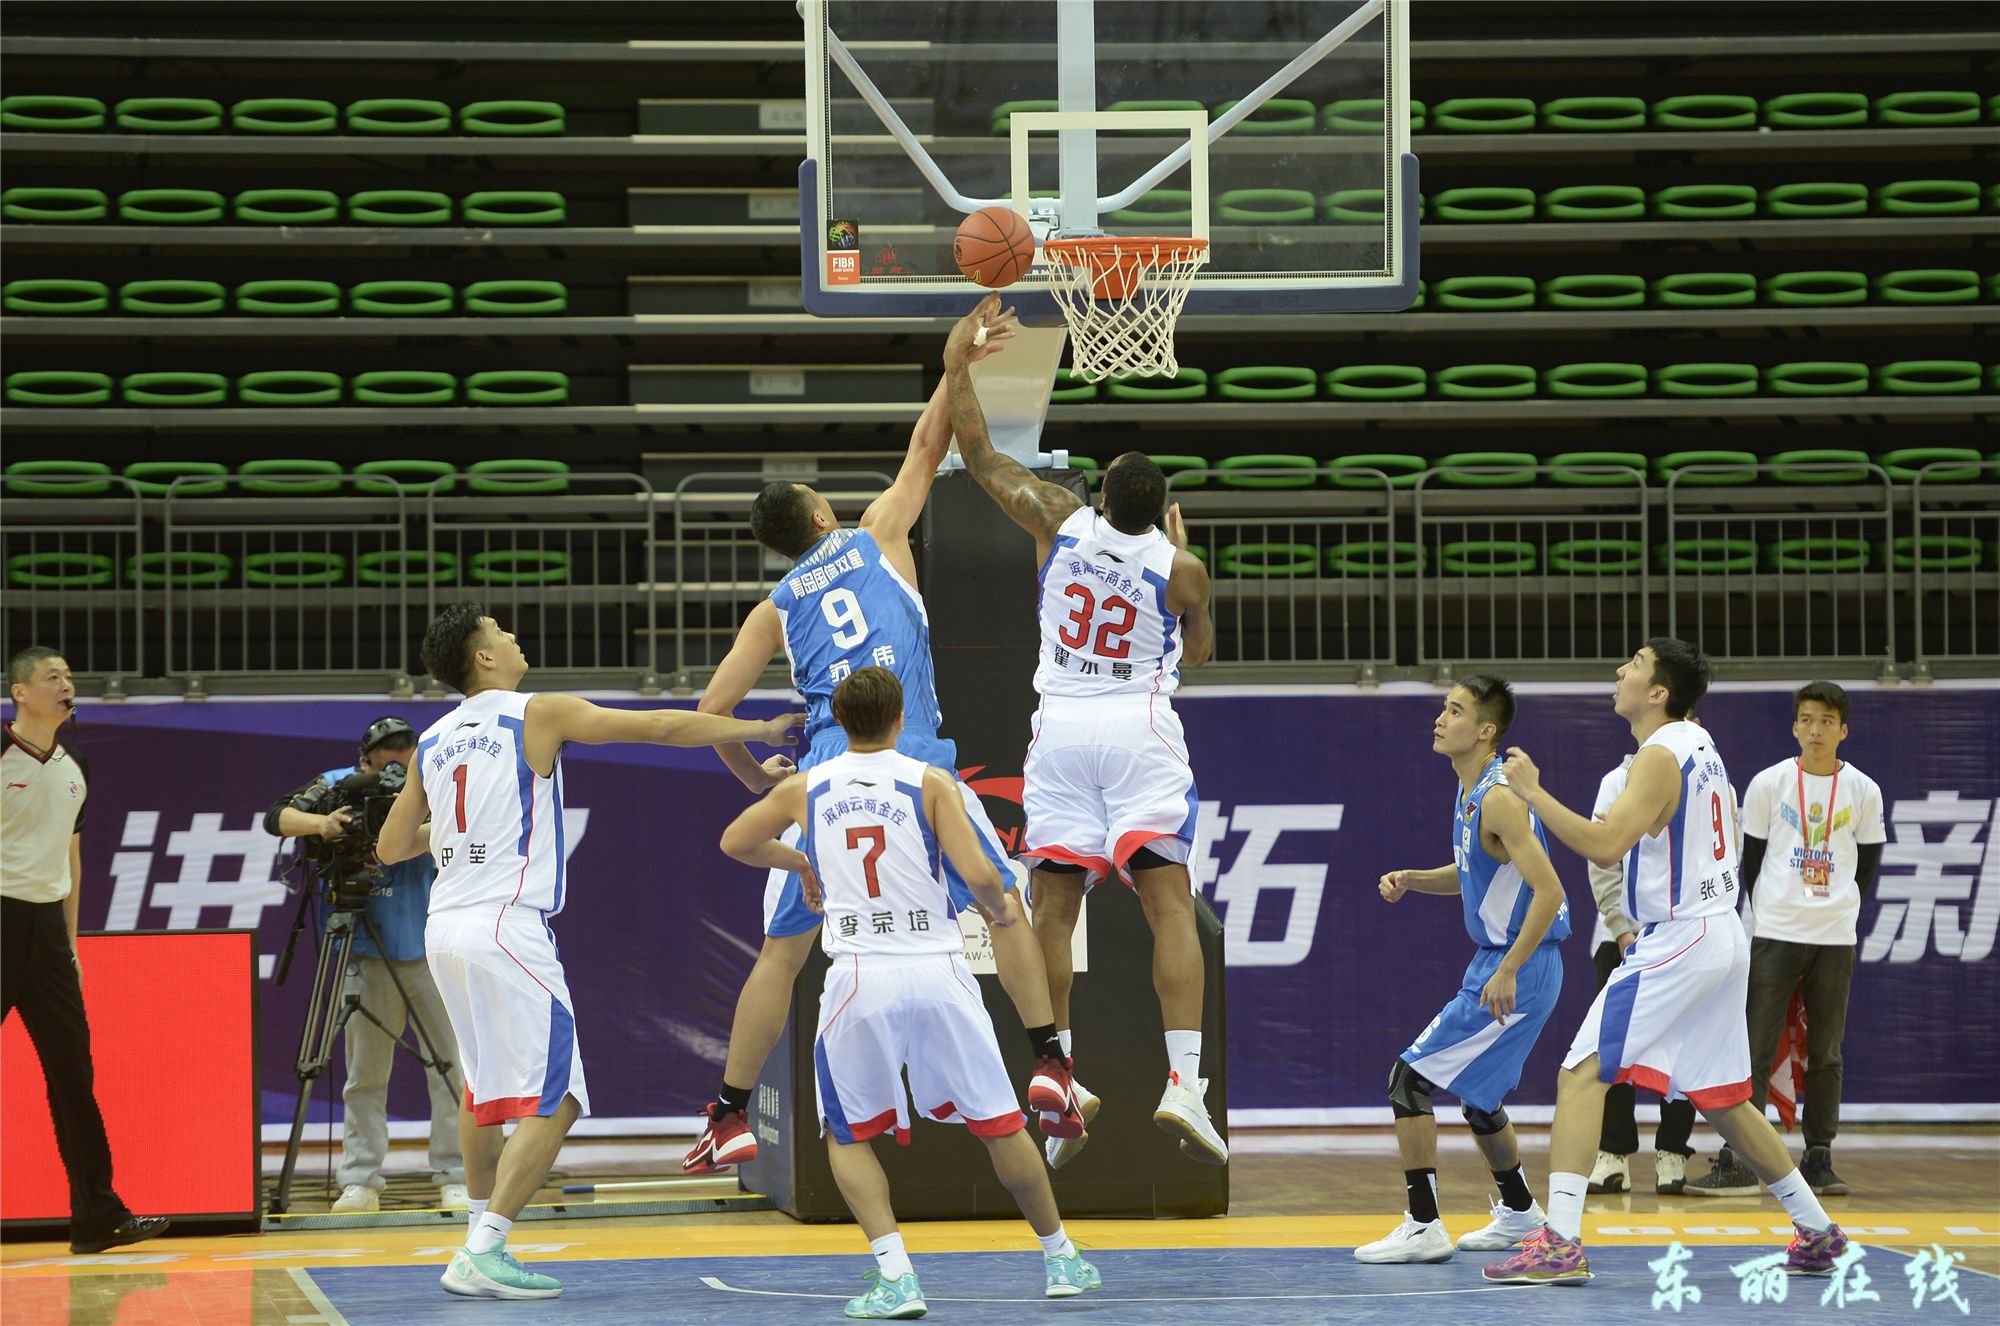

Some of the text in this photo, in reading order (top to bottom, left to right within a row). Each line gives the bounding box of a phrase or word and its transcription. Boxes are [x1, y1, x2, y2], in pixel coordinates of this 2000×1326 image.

[833, 257, 854, 268] FIBA
[788, 548, 865, 599] 青岛国信双星
[1069, 560, 1143, 604] 滨海云商金控
[820, 587, 869, 649] 9
[1059, 582, 1137, 659] 32
[453, 764, 468, 833] 1
[822, 796, 907, 827] 滨海云商金控
[1711, 790, 1726, 861] 9
[845, 825, 886, 898] 7
[839, 909, 930, 938] 李荣培
